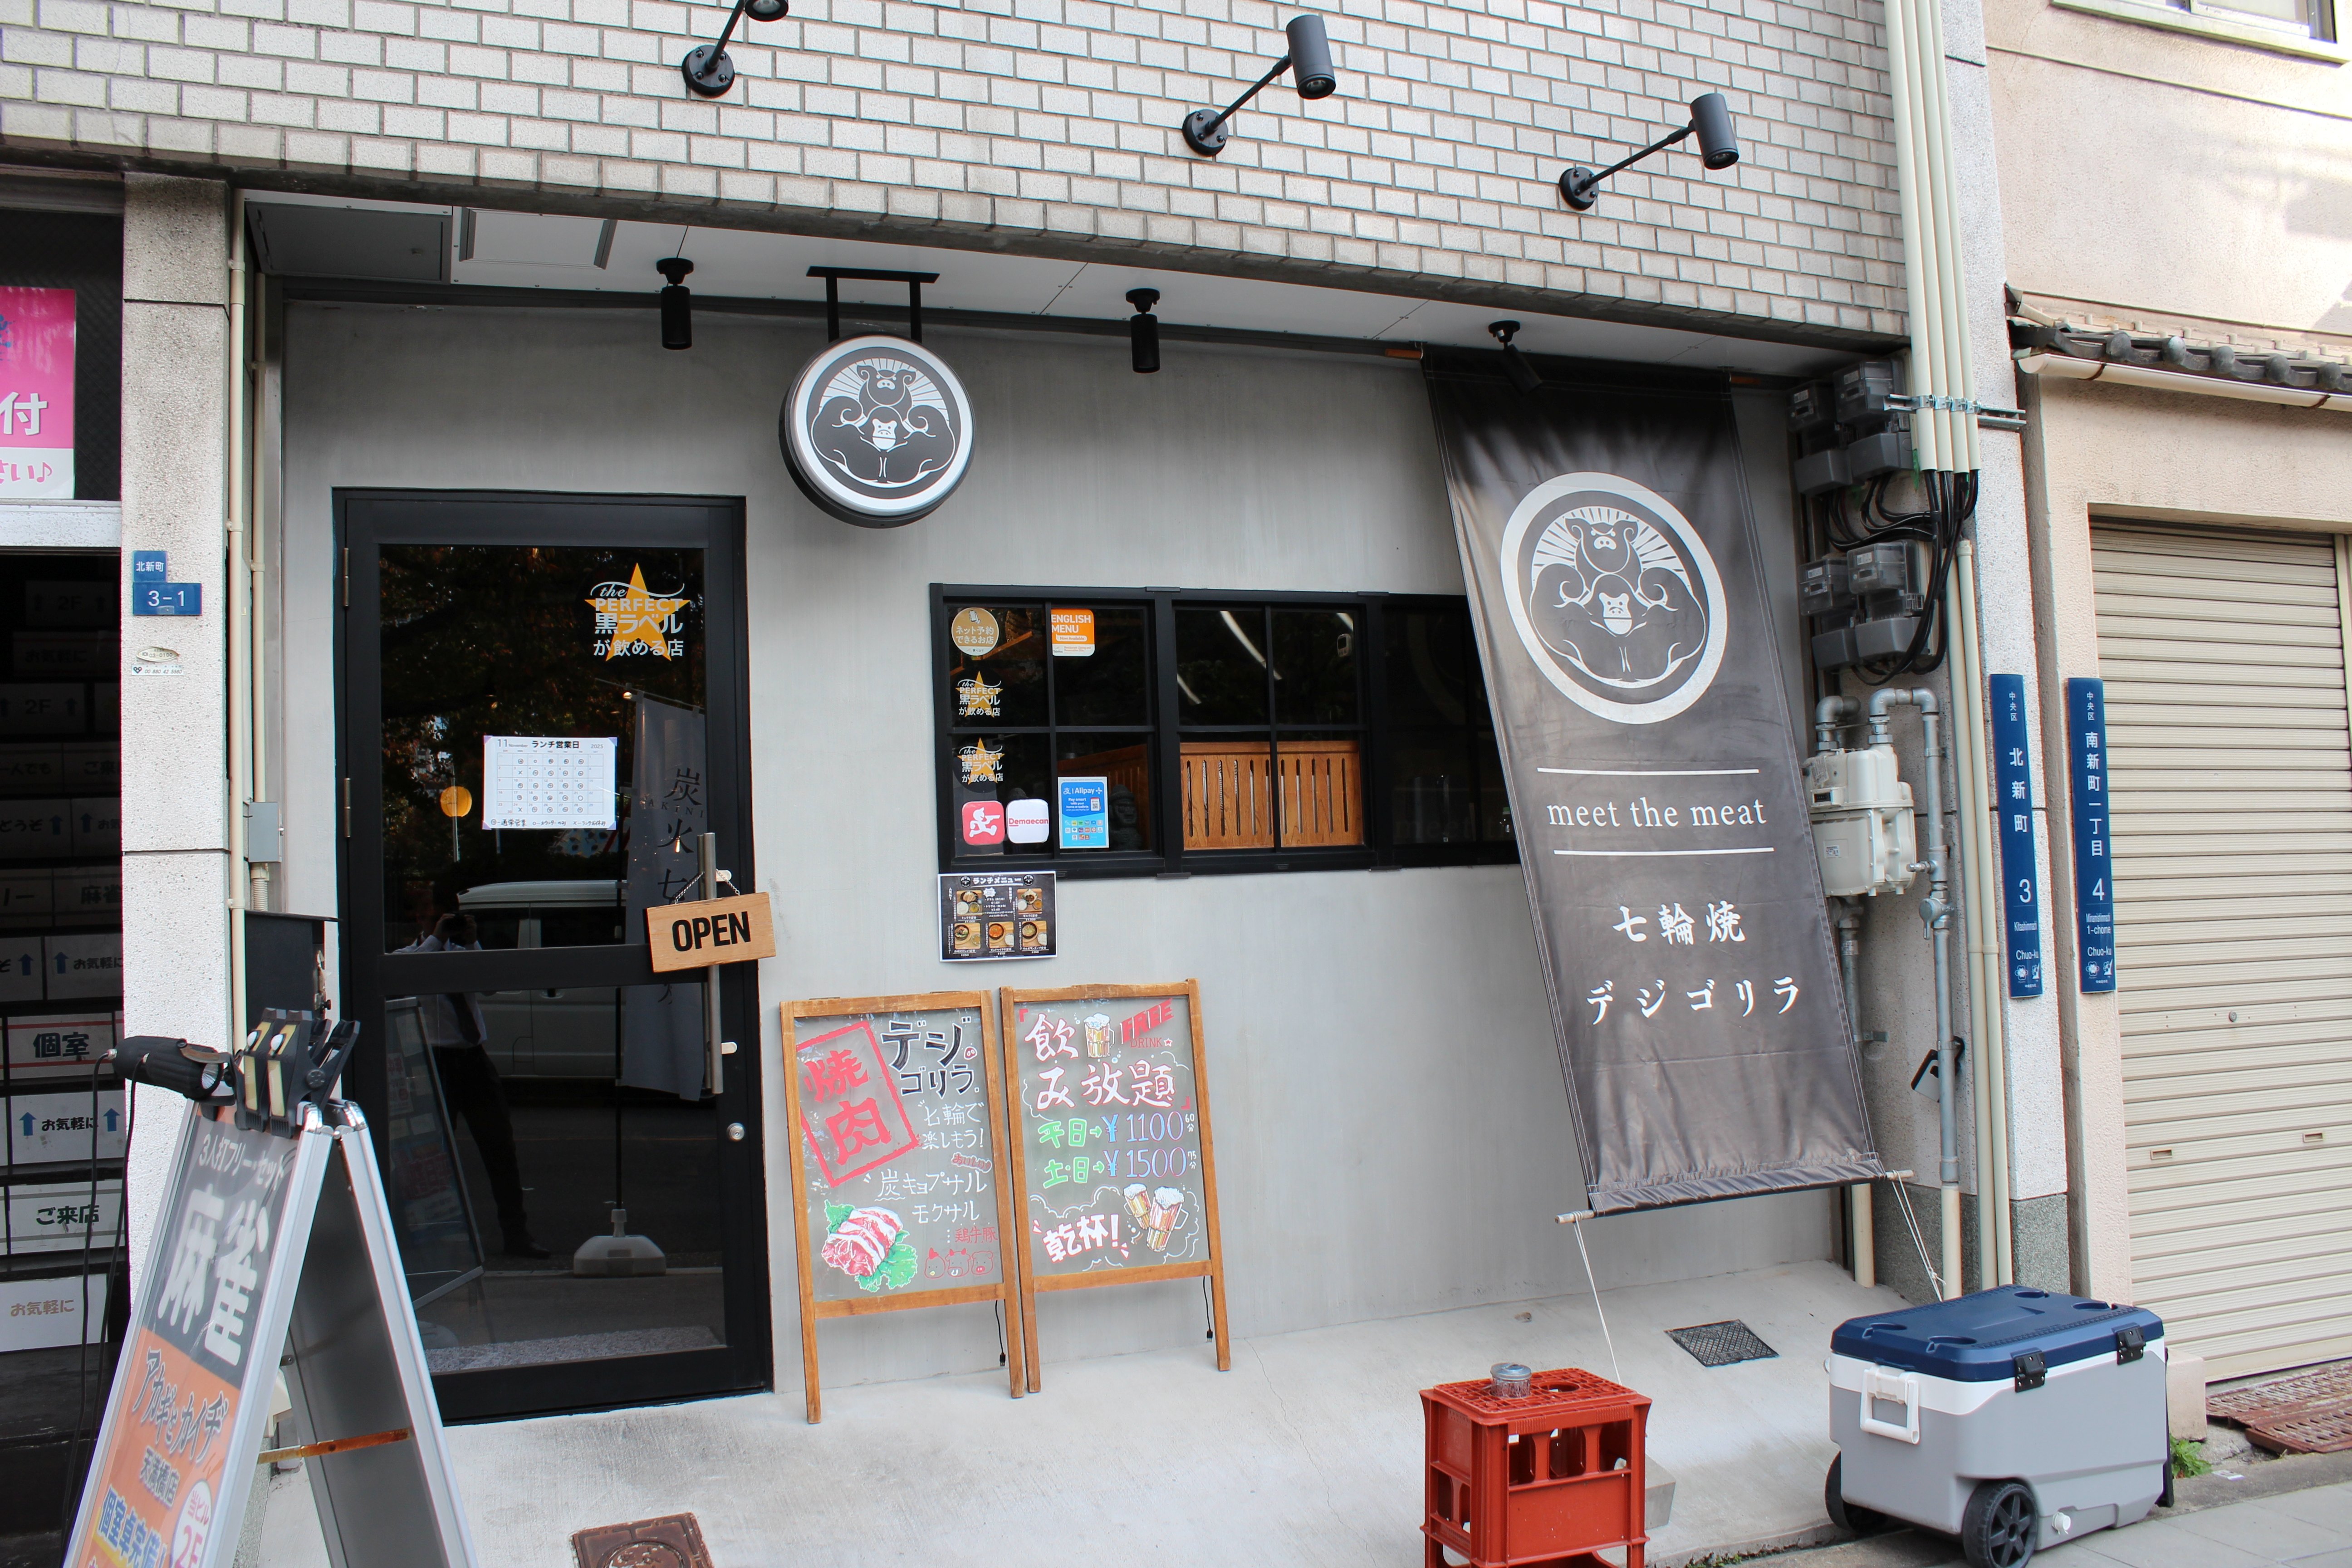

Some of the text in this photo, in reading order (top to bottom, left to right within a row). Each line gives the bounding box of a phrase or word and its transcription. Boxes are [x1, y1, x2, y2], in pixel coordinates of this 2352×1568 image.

[136, 561, 164, 572] 北新町
[148, 590, 184, 607] 3-1
[599, 584, 627, 597] the
[57, 596, 83, 610] 2F
[595, 598, 683, 612] PERFECT
[595, 612, 683, 634] 黒ラベル
[1051, 614, 1091, 623] ENGLISH
[956, 626, 994, 635] ネット予約
[1051, 624, 1079, 633] MENU
[593, 639, 684, 657] が飲める店
[956, 636, 994, 644] できるお店
[25, 699, 51, 715] 2F
[959, 694, 1000, 706] 黒ラベル
[2009, 691, 2017, 721] 中央区
[2087, 691, 2095, 721] 中央区
[959, 707, 1000, 716] が飲める店
[498, 739, 508, 747] 11
[531, 740, 580, 749] ランチ営業日
[961, 753, 1002, 761] PERFECT
[962, 761, 1003, 773] 黒ラベル
[961, 773, 1004, 783] が飲める店
[2009, 747, 2028, 833] 北新町
[2085, 731, 2103, 857] 南新町一丁目
[1546, 797, 1767, 828] meet the meat
[2019, 878, 2031, 903] 3
[2092, 878, 2105, 901] 4
[672, 911, 751, 951] OPEN
[1612, 901, 1746, 945] 七輪焼
[2087, 925, 2111, 935] 1-chome
[2016, 949, 2039, 960] Chuo-ku
[2087, 946, 2112, 956] Chuo-ku
[1587, 976, 1799, 1025] デジゴリラ
[1119, 998, 1174, 1044] FREE
[33, 1032, 90, 1058] 個室
[880, 1016, 971, 1072] デジ
[1130, 1038, 1163, 1048] DRINK
[804, 1049, 892, 1166] 焼肉
[42, 1117, 97, 1131] お気軽に
[1038, 1118, 1088, 1149] 平日
[1101, 1111, 1184, 1143] ¥1100
[1103, 1147, 1187, 1179] ¥1500
[877, 1168, 987, 1197] 炭キョプサル
[36, 1205, 100, 1225] ご来店
[912, 1200, 980, 1224] モクサル
[1043, 1214, 1119, 1264] 乾杯!
[158, 1183, 270, 1367] 麻雀
[11, 1298, 75, 1317] お気軽に
[140, 1446, 181, 1508] 天満橋店
